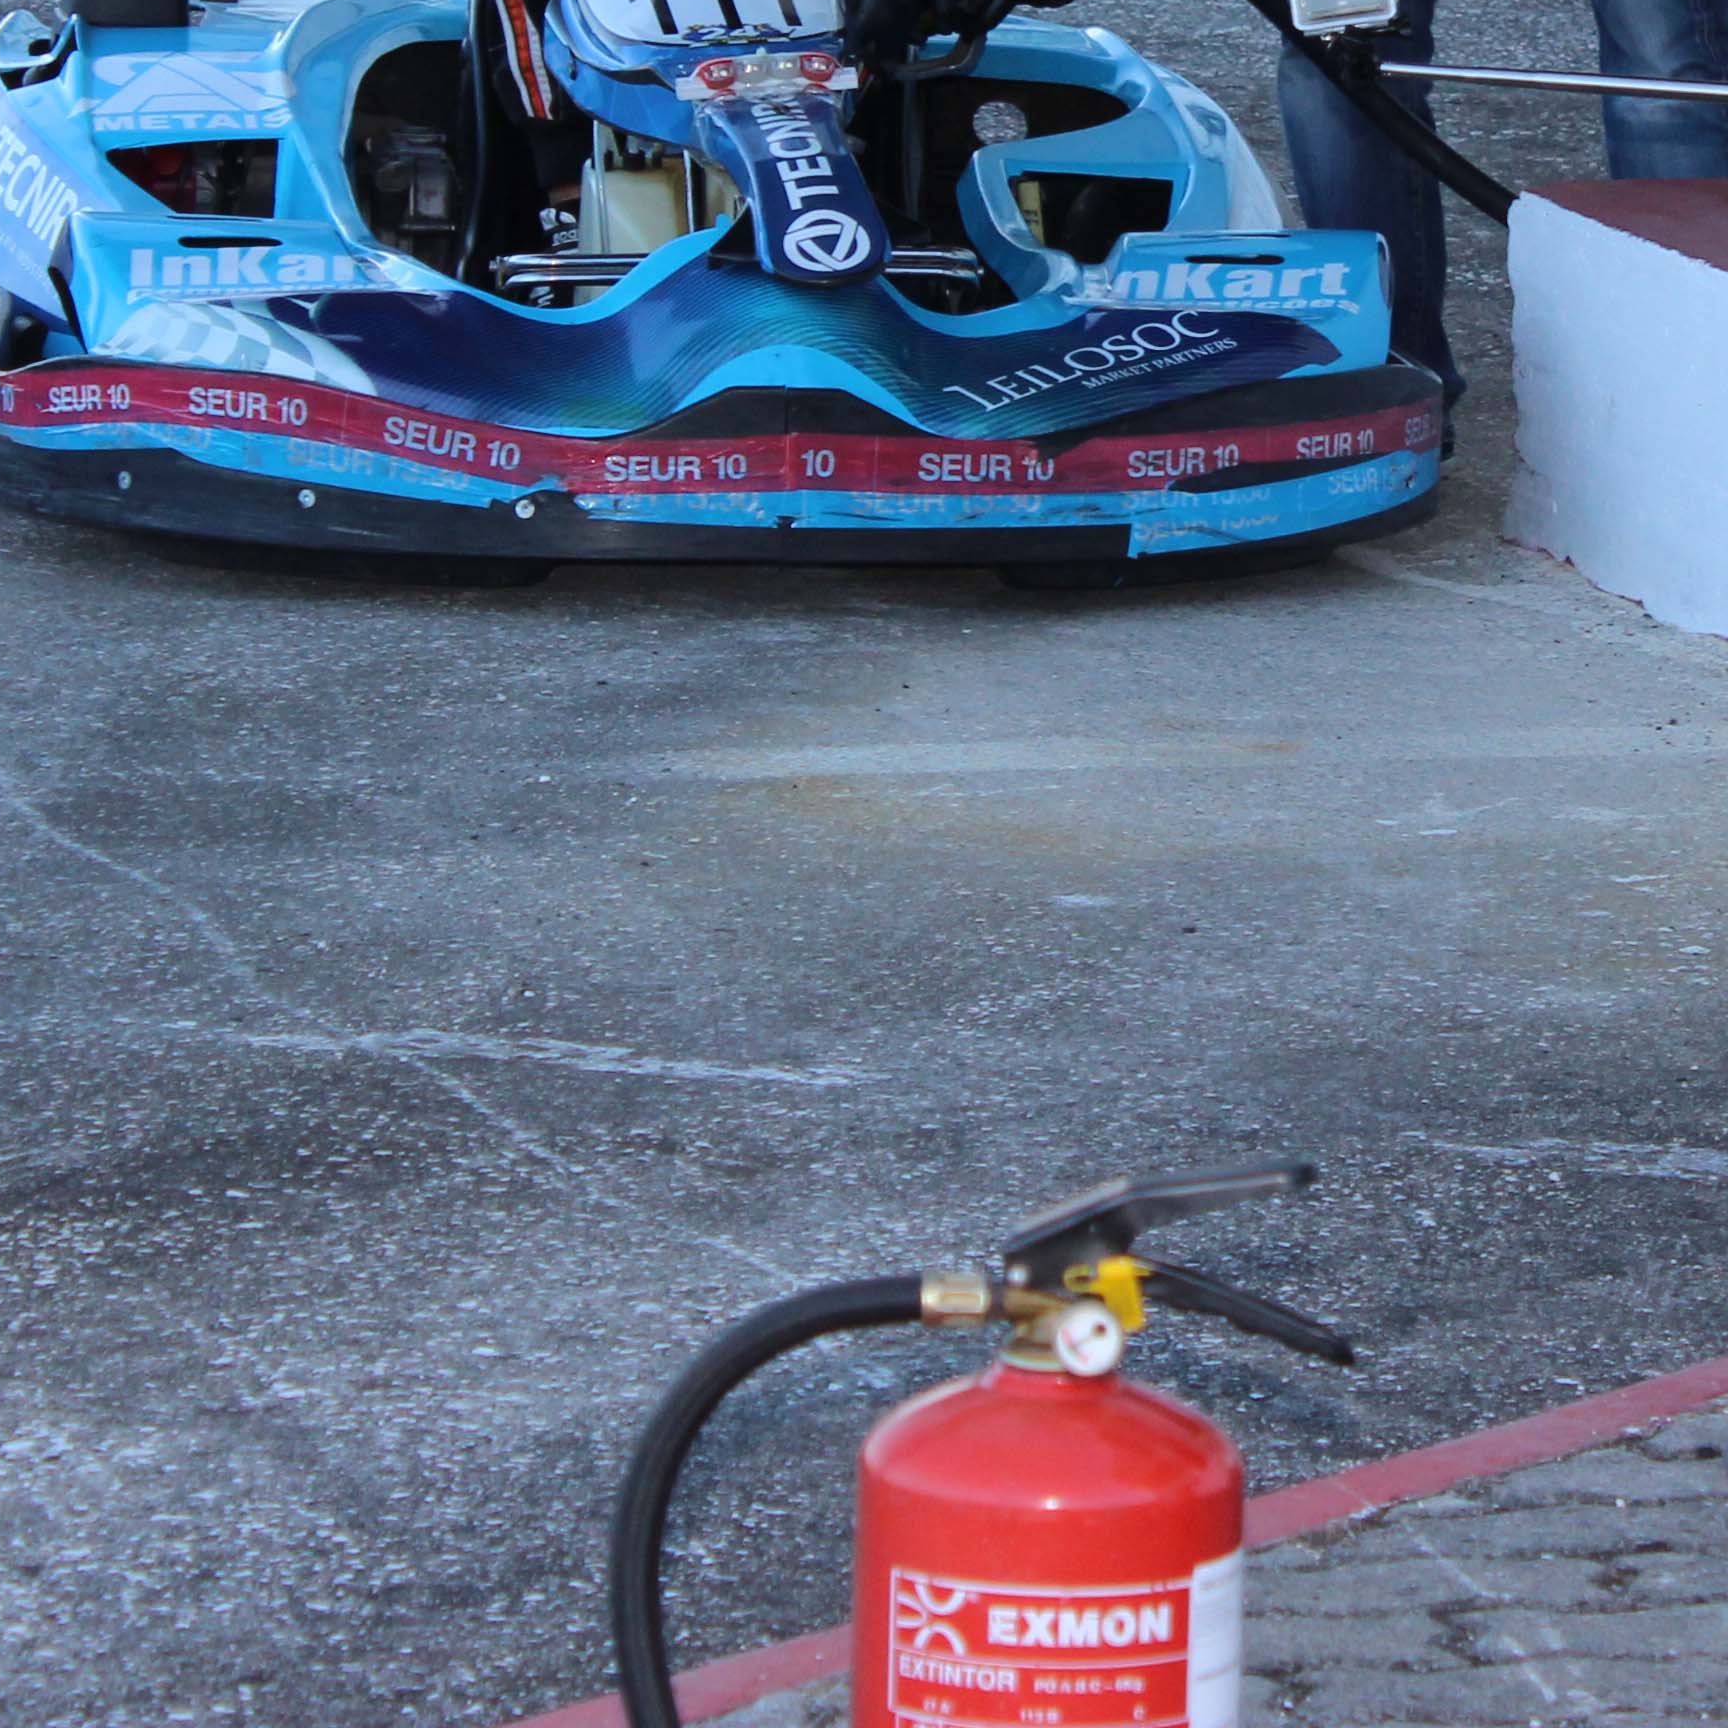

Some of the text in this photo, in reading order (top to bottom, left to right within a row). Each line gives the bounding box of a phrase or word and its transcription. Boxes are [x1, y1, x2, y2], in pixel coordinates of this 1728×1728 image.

[93, 105, 294, 132] METAIS
[943, 308, 1219, 413] LEILOSOC
[1079, 336, 1238, 390] MARKET PARTNERS
[47, 383, 131, 414] SEUR 10
[187, 386, 308, 427] SEUR 10
[382, 415, 521, 471] SEUR 10
[1357, 428, 1375, 455] 10
[603, 453, 748, 483] SEUR 10
[800, 448, 836, 479] 10
[917, 452, 1013, 483] SEUR
[1126, 443, 1240, 479] SEUR 10
[986, 1602, 1173, 1649] EXMON
[898, 1654, 1019, 1694] EXTINTOR
